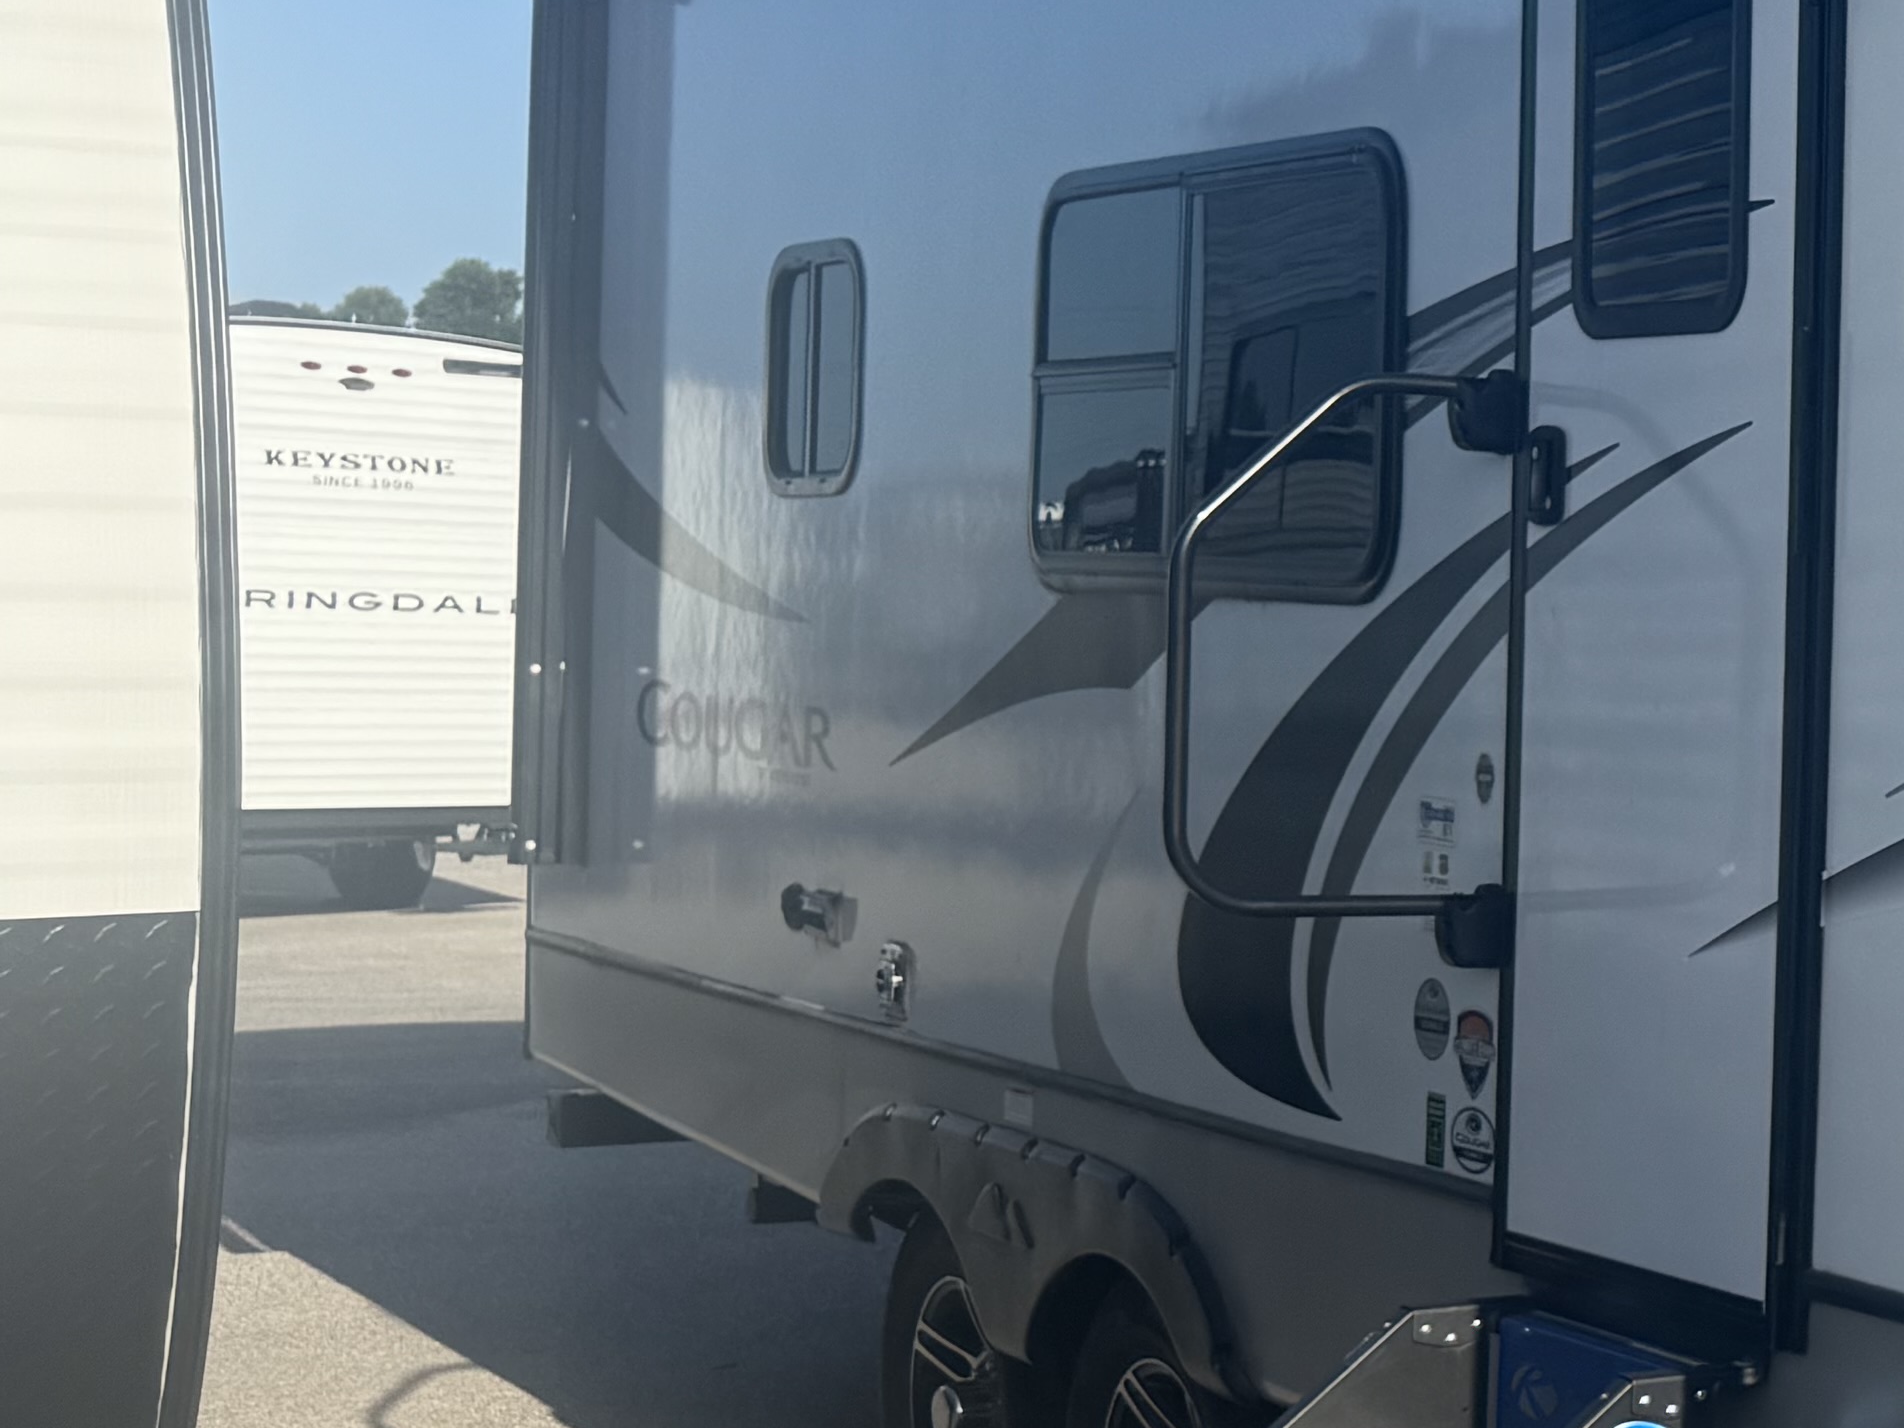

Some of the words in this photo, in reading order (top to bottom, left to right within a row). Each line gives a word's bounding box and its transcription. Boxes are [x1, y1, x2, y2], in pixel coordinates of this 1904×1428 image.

[263, 448, 456, 477] KEYSTONE
[311, 474, 360, 488] SINCE
[244, 588, 517, 615] RINGDAL
[636, 678, 837, 772] COUGAR
